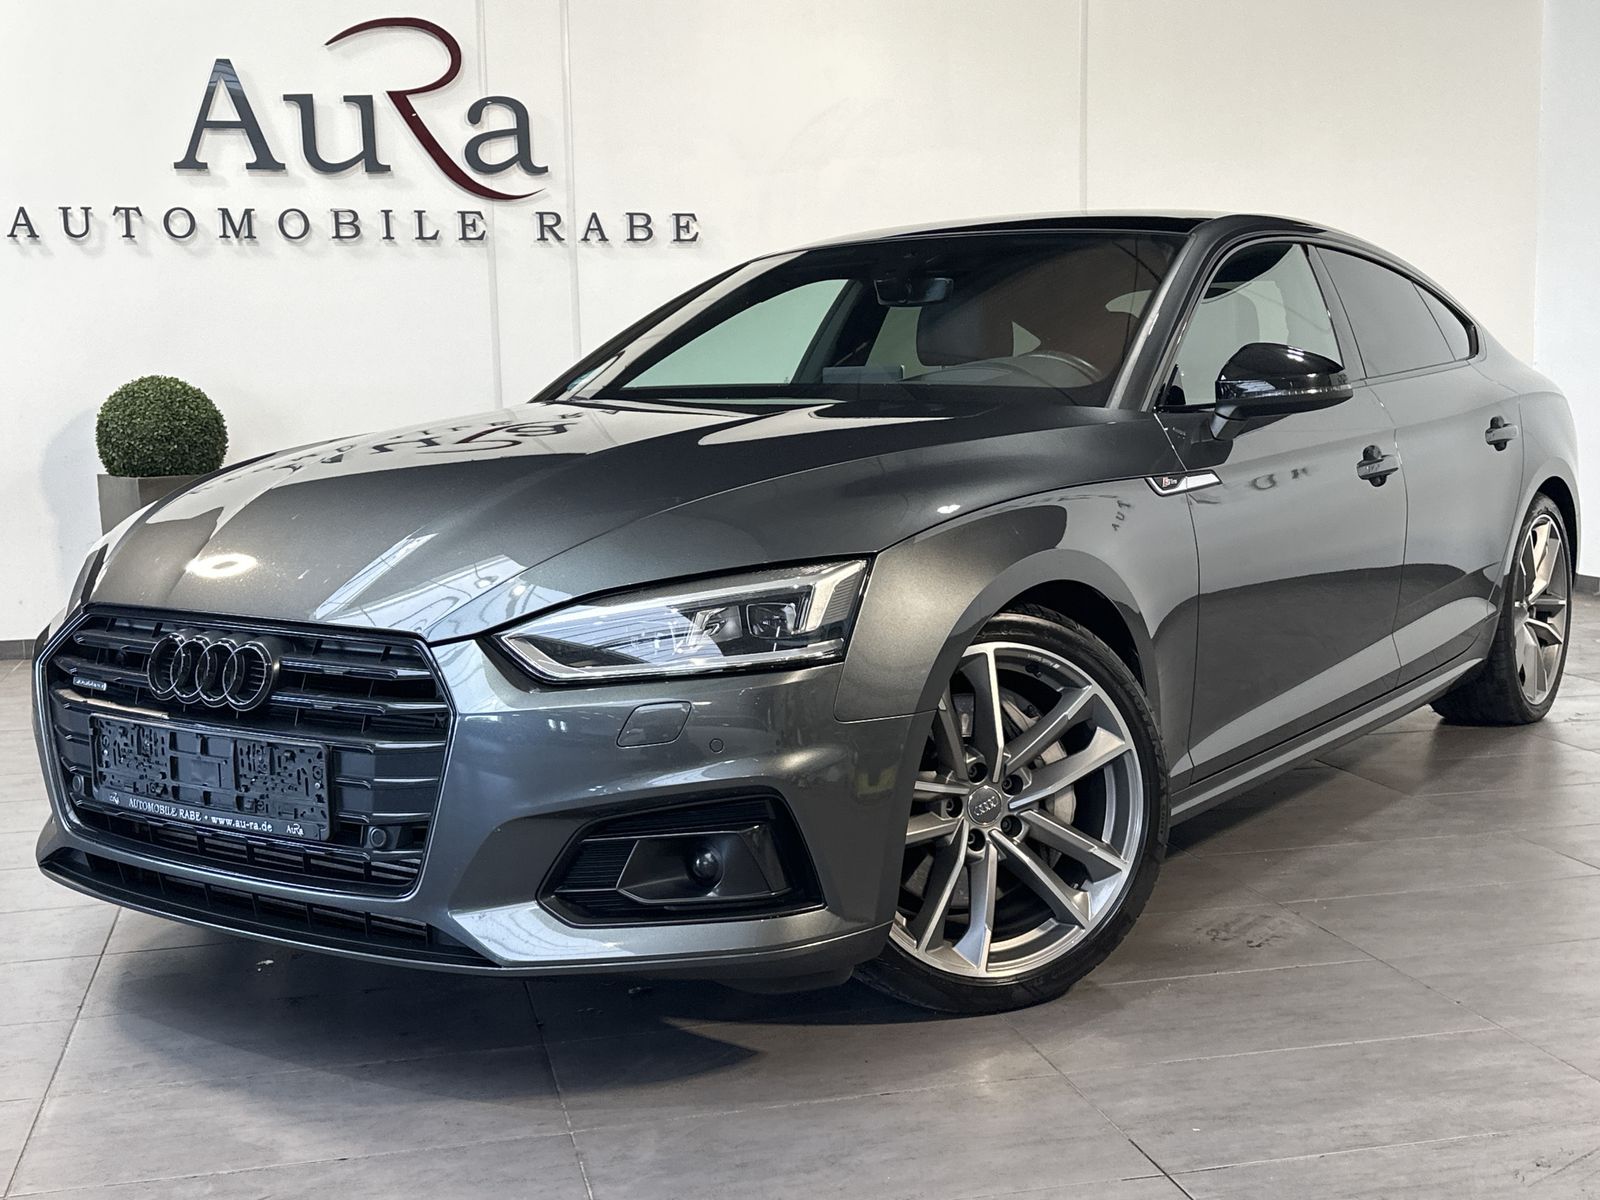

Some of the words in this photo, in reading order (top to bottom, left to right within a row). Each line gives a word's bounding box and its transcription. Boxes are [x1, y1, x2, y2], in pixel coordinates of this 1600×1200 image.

[174, 17, 549, 202] AuRa
[8, 206, 487, 242] AUTOMOBILE
[536, 211, 700, 243] RABE
[129, 798, 177, 817] AUTOMOBILE
[179, 808, 202, 822] RABE
[211, 816, 273, 833] www.au-ra.de
